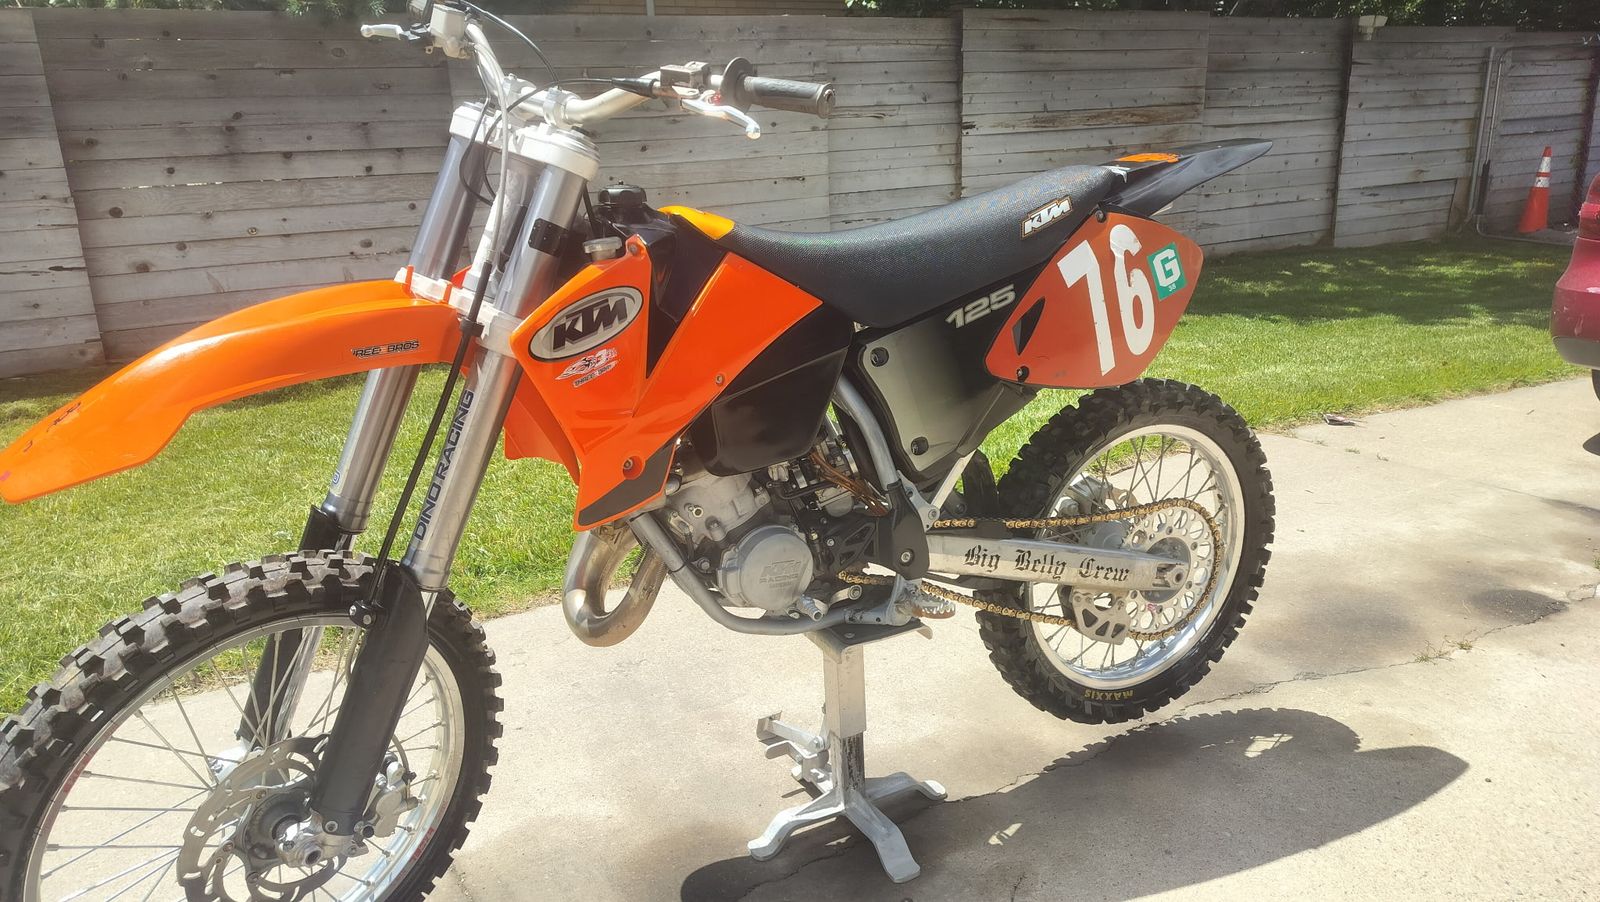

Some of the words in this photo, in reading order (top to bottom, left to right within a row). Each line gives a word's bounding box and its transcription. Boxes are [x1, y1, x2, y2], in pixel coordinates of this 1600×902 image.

[1022, 197, 1072, 237] KTM
[1153, 248, 1181, 287] G
[945, 284, 1016, 328] 125
[1057, 224, 1155, 376] 76
[552, 297, 629, 352] KTM
[387, 340, 420, 352] BROS
[414, 482, 441, 541] DINO
[436, 389, 475, 481] RACING
[964, 544, 1001, 573] Big
[1015, 548, 1067, 581] Belly
[1078, 556, 1130, 582] Crew
[1084, 688, 1134, 702] MAXXIS
